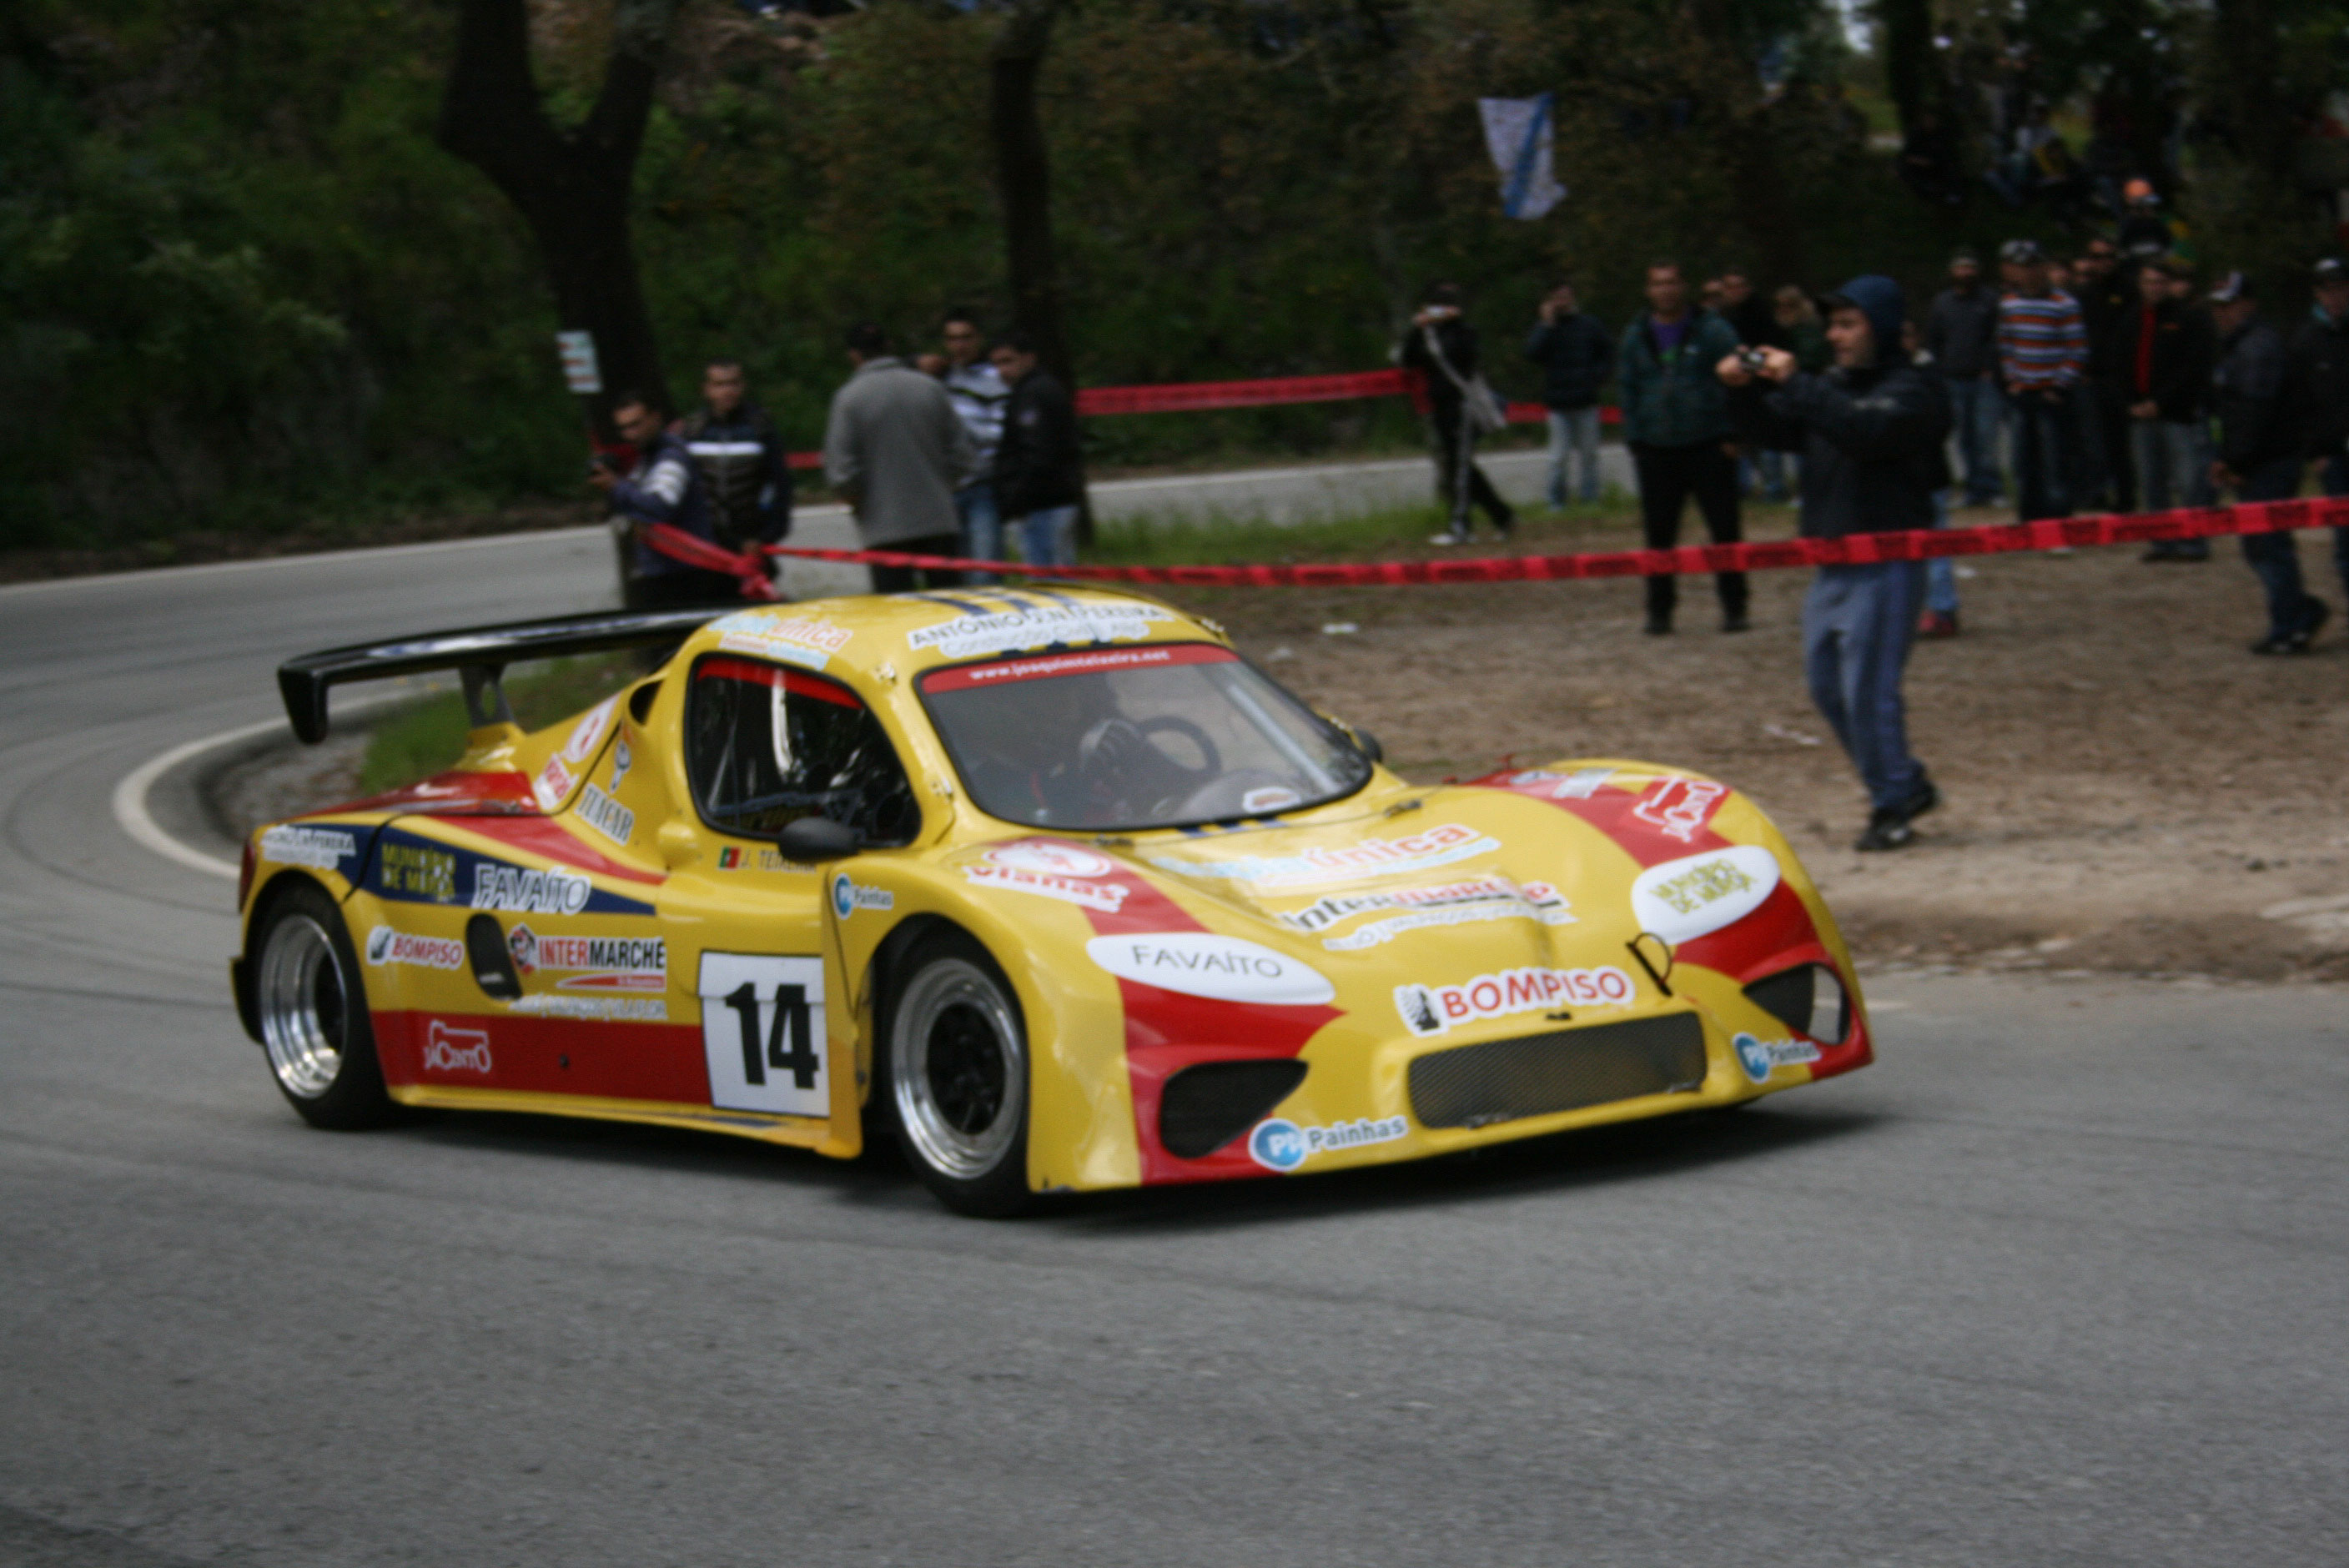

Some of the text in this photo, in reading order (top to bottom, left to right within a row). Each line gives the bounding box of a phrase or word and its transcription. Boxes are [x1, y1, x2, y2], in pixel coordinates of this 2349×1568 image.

[392, 936, 462, 965] BOMPISO
[1441, 971, 1626, 1018] BOMPISO
[724, 981, 819, 1089] 14
[1309, 1118, 1404, 1149] Painhas
